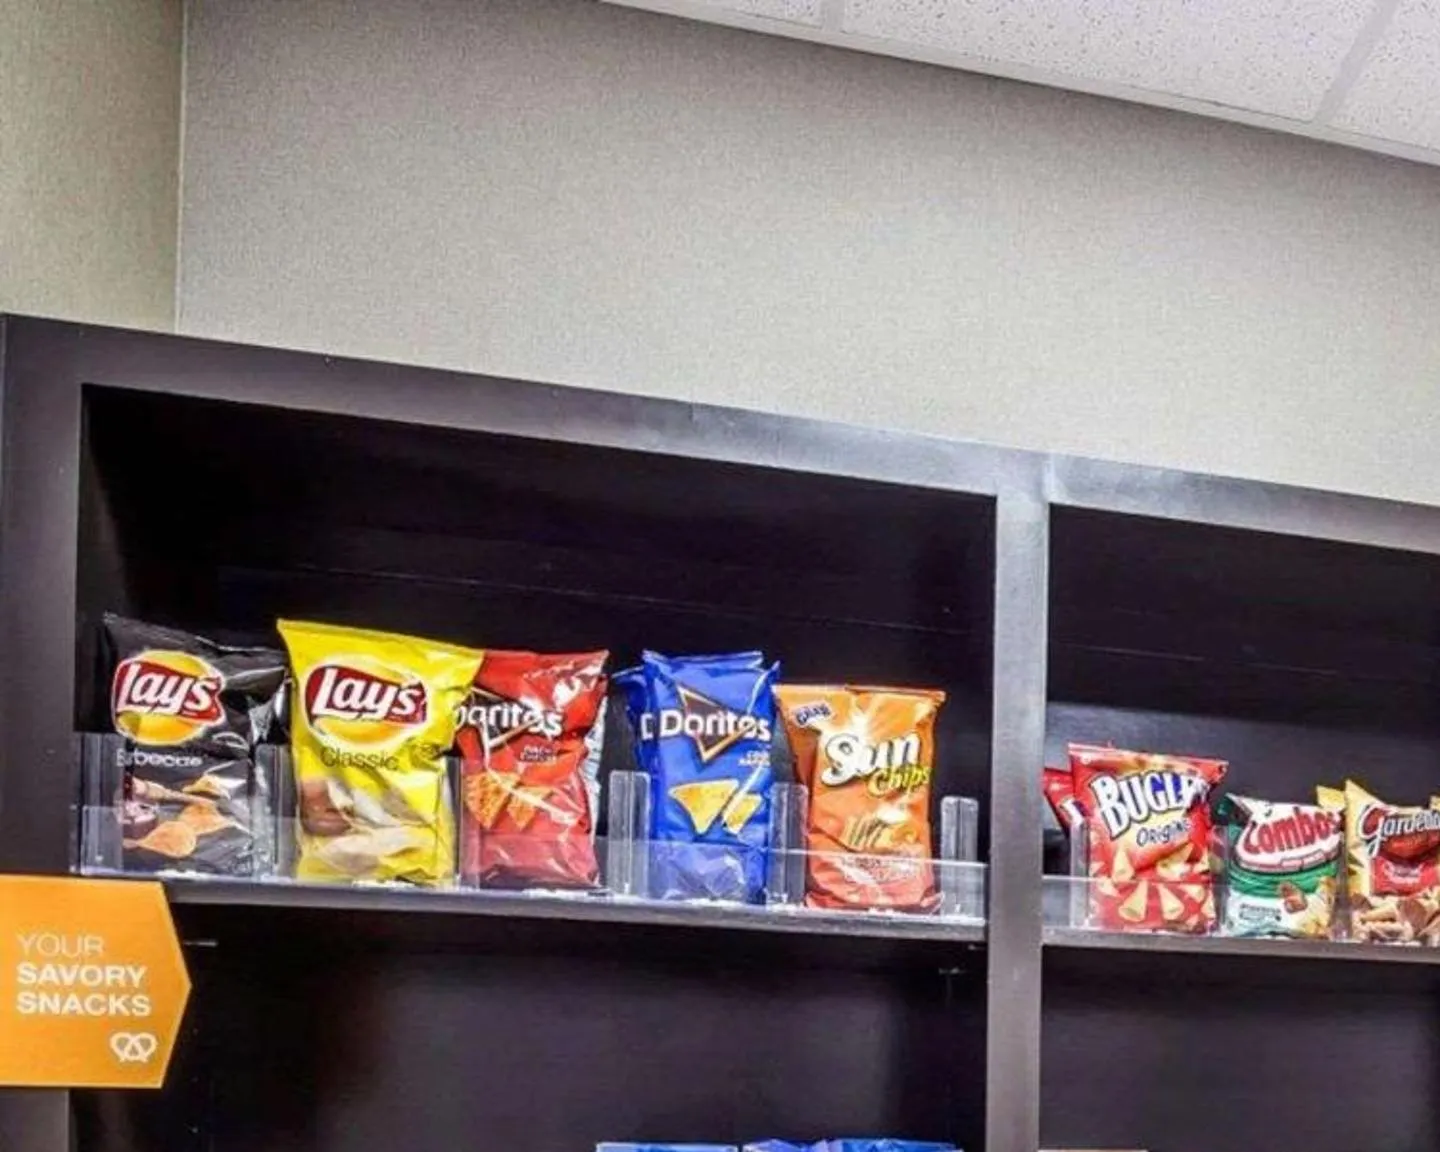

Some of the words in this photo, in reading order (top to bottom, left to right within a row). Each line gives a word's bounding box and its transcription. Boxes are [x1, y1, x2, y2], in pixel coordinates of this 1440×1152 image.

[660, 709, 772, 741] Doritos
[320, 747, 401, 773] Classic
[822, 733, 921, 786] Sun
[16, 932, 105, 957] YOUR
[16, 962, 148, 988] SAVORY
[16, 991, 151, 1017] SNACKS
